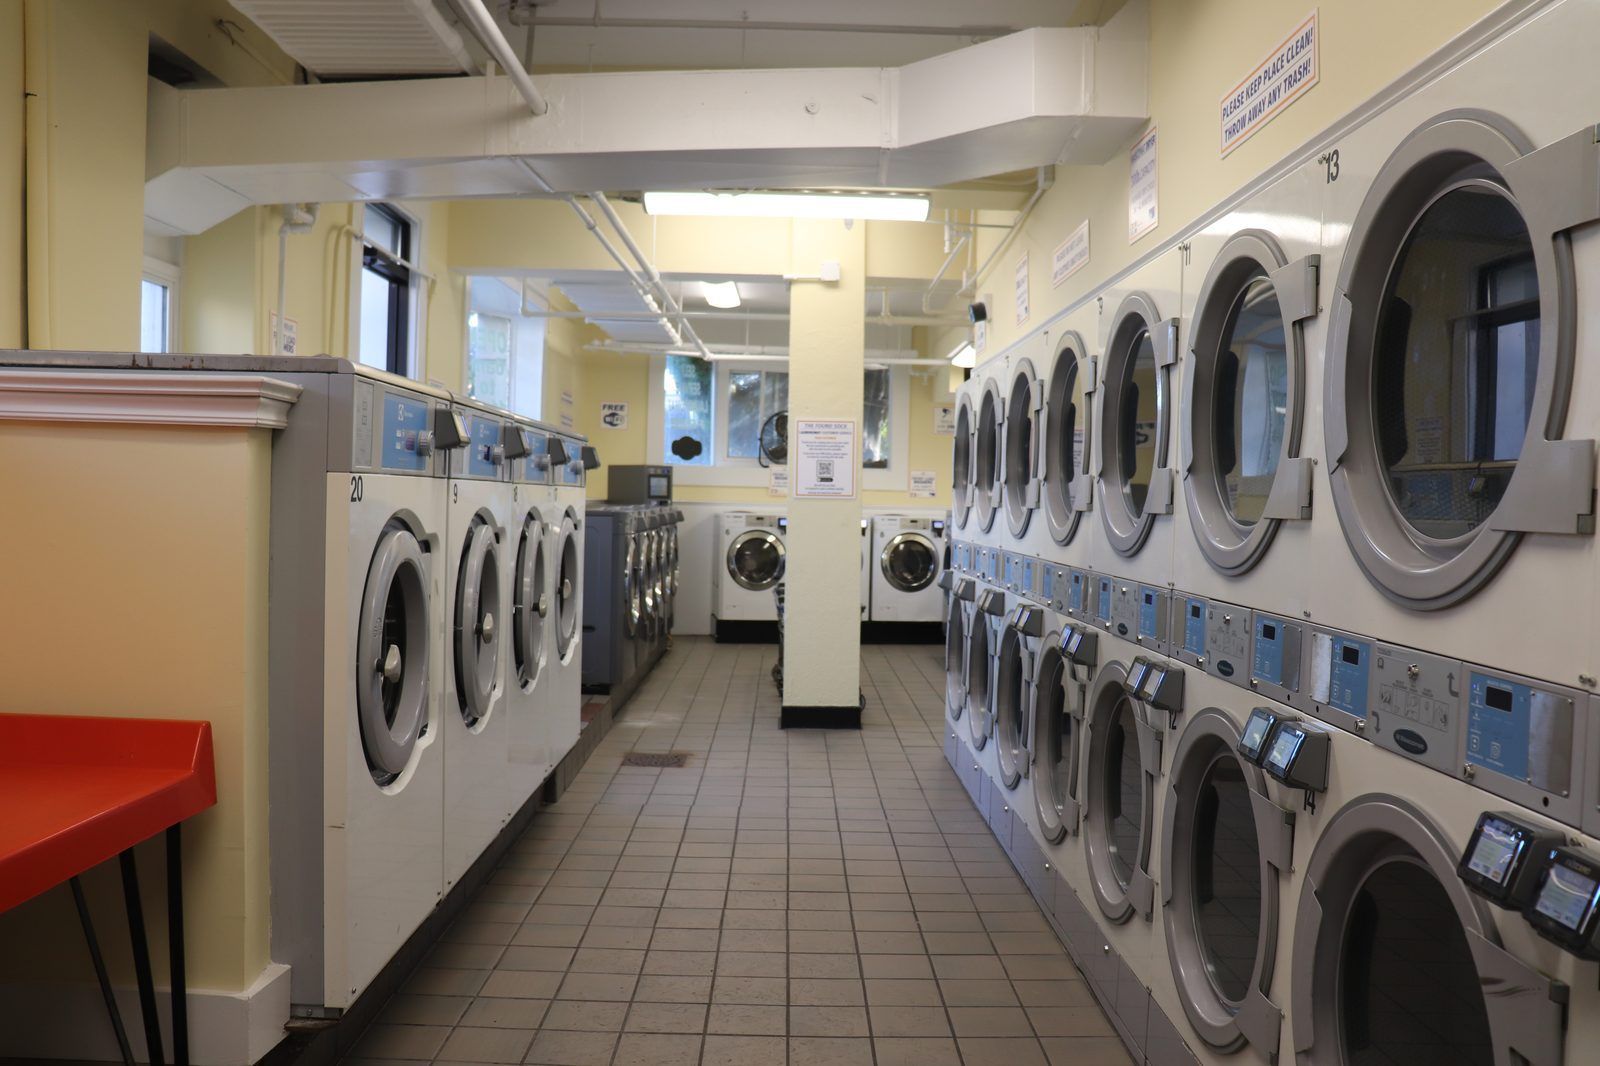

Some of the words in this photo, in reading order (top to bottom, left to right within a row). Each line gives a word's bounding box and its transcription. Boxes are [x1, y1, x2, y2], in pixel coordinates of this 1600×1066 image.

[1222, 92, 1245, 121] PLEASE
[1245, 76, 1262, 101] KEEP
[1263, 54, 1285, 86] PLACE
[1286, 26, 1313, 64] CLEAN!
[1224, 114, 1247, 143] THROW
[1247, 97, 1266, 123] AWAY
[1267, 83, 1283, 107] ANY
[1283, 57, 1311, 94] TRASH!
[1325, 149, 1339, 184] 13
[350, 475, 363, 502] 20
[453, 484, 458, 504] 9
